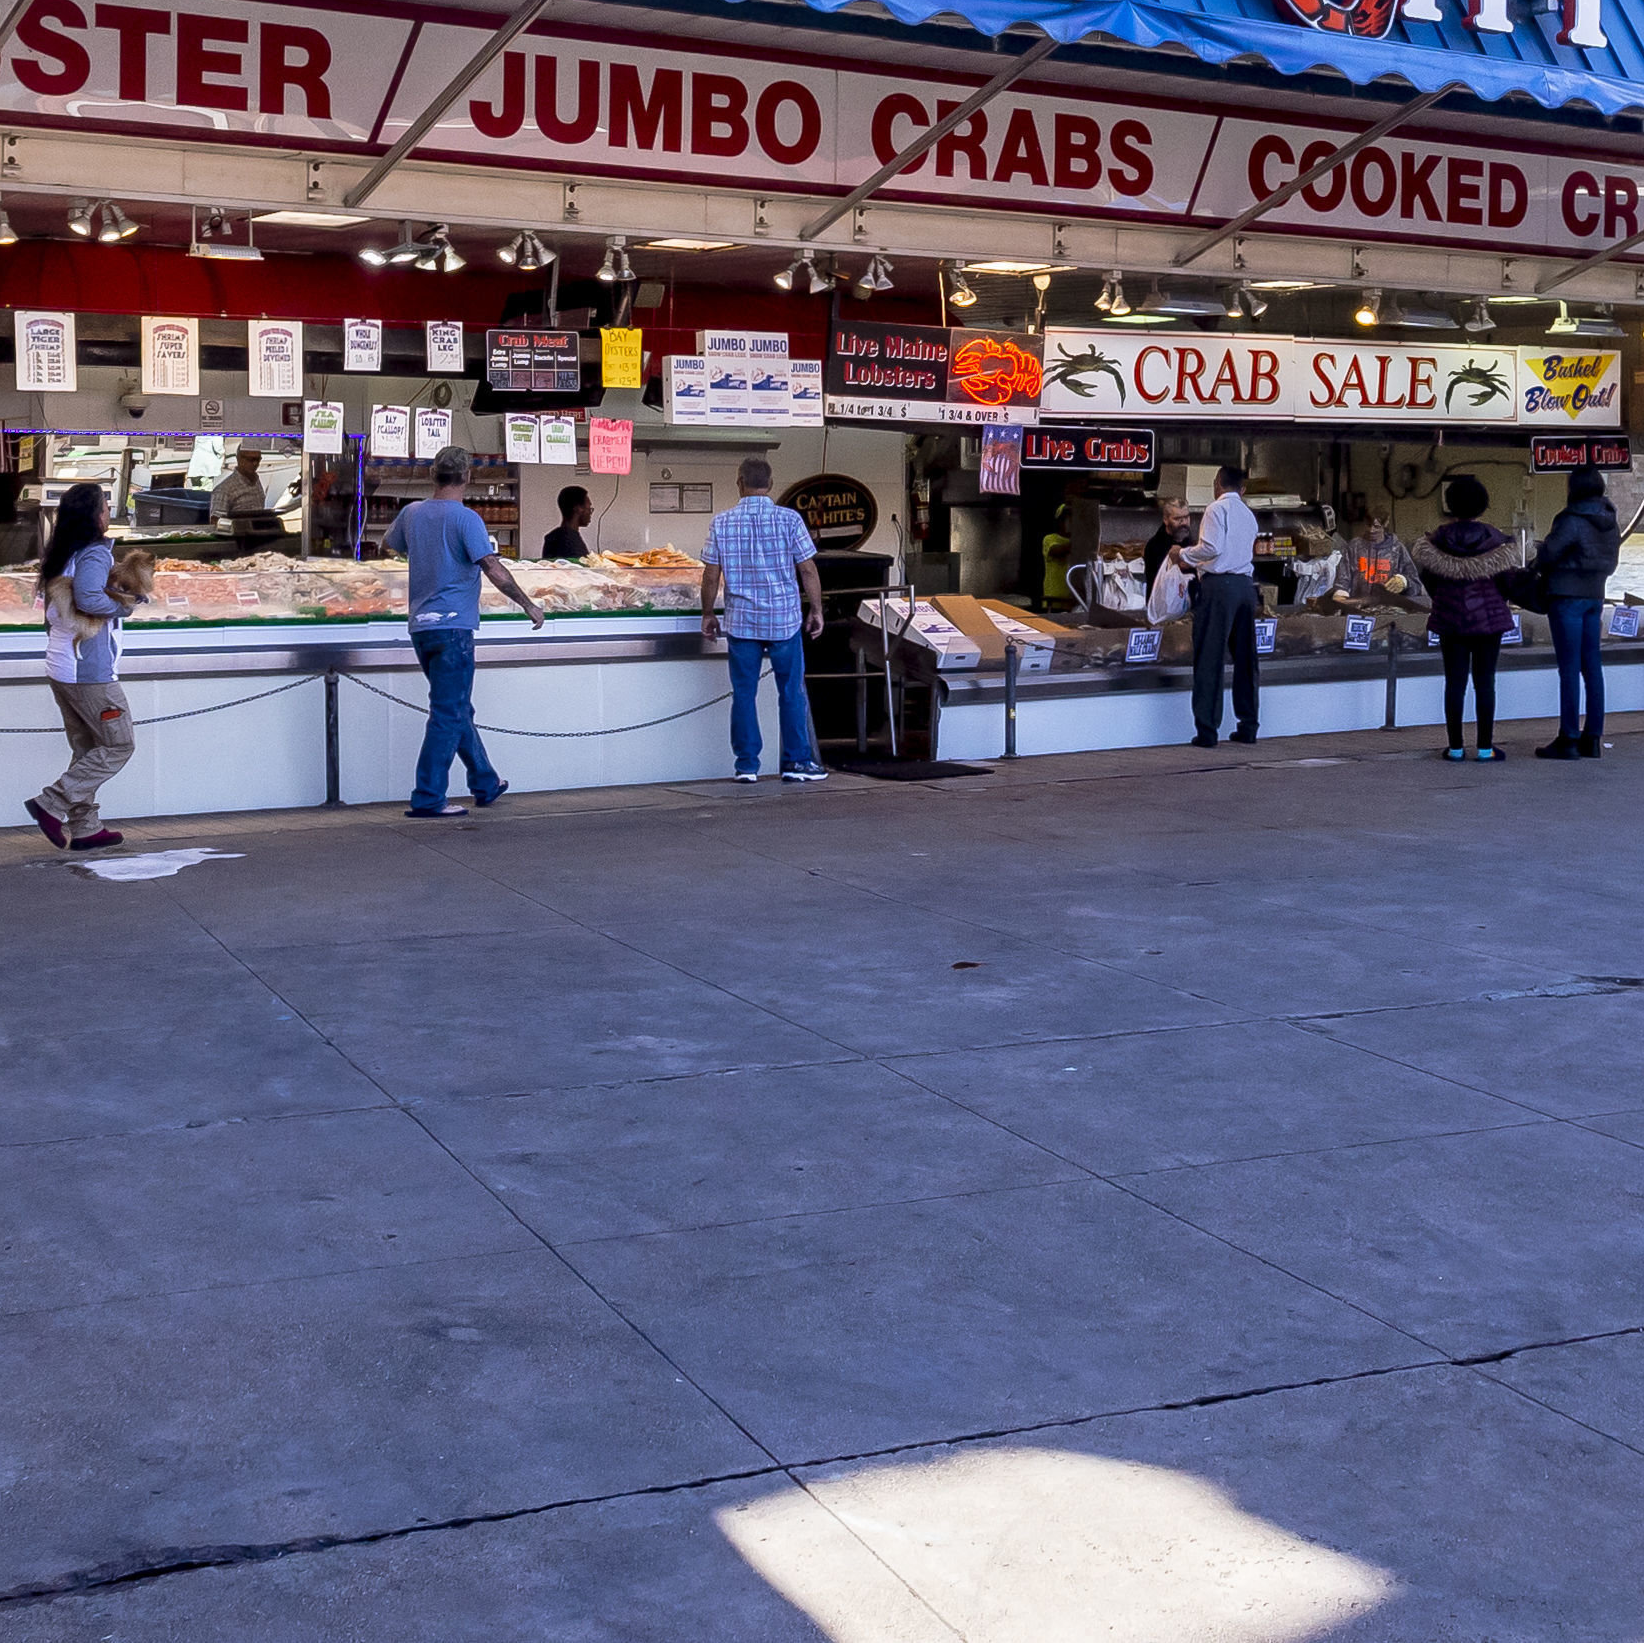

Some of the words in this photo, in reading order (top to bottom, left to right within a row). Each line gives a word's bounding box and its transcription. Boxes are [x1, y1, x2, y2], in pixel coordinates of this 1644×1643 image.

[468, 50, 822, 166] JUMBO
[871, 92, 1154, 198] CRABS
[1247, 133, 1529, 229] COOKED
[707, 337, 746, 351] JUMBO
[749, 339, 788, 353] JUMBO
[836, 332, 879, 358] Live
[884, 335, 948, 362] Maine
[673, 359, 705, 370] JUMBO
[790, 362, 820, 373] JUMBO
[844, 361, 937, 389] Lobsters
[1133, 345, 1281, 406] CRAB
[1309, 349, 1438, 410] SALE
[1542, 354, 1602, 382] Bushel
[1524, 385, 1570, 414] Blow
[1571, 383, 1617, 411] Out!
[965, 411, 972, 421] &
[974, 411, 998, 422] OVER
[1025, 435, 1075, 461] Live
[1084, 437, 1150, 464] Crabs
[796, 491, 857, 511] CAPTAIN
